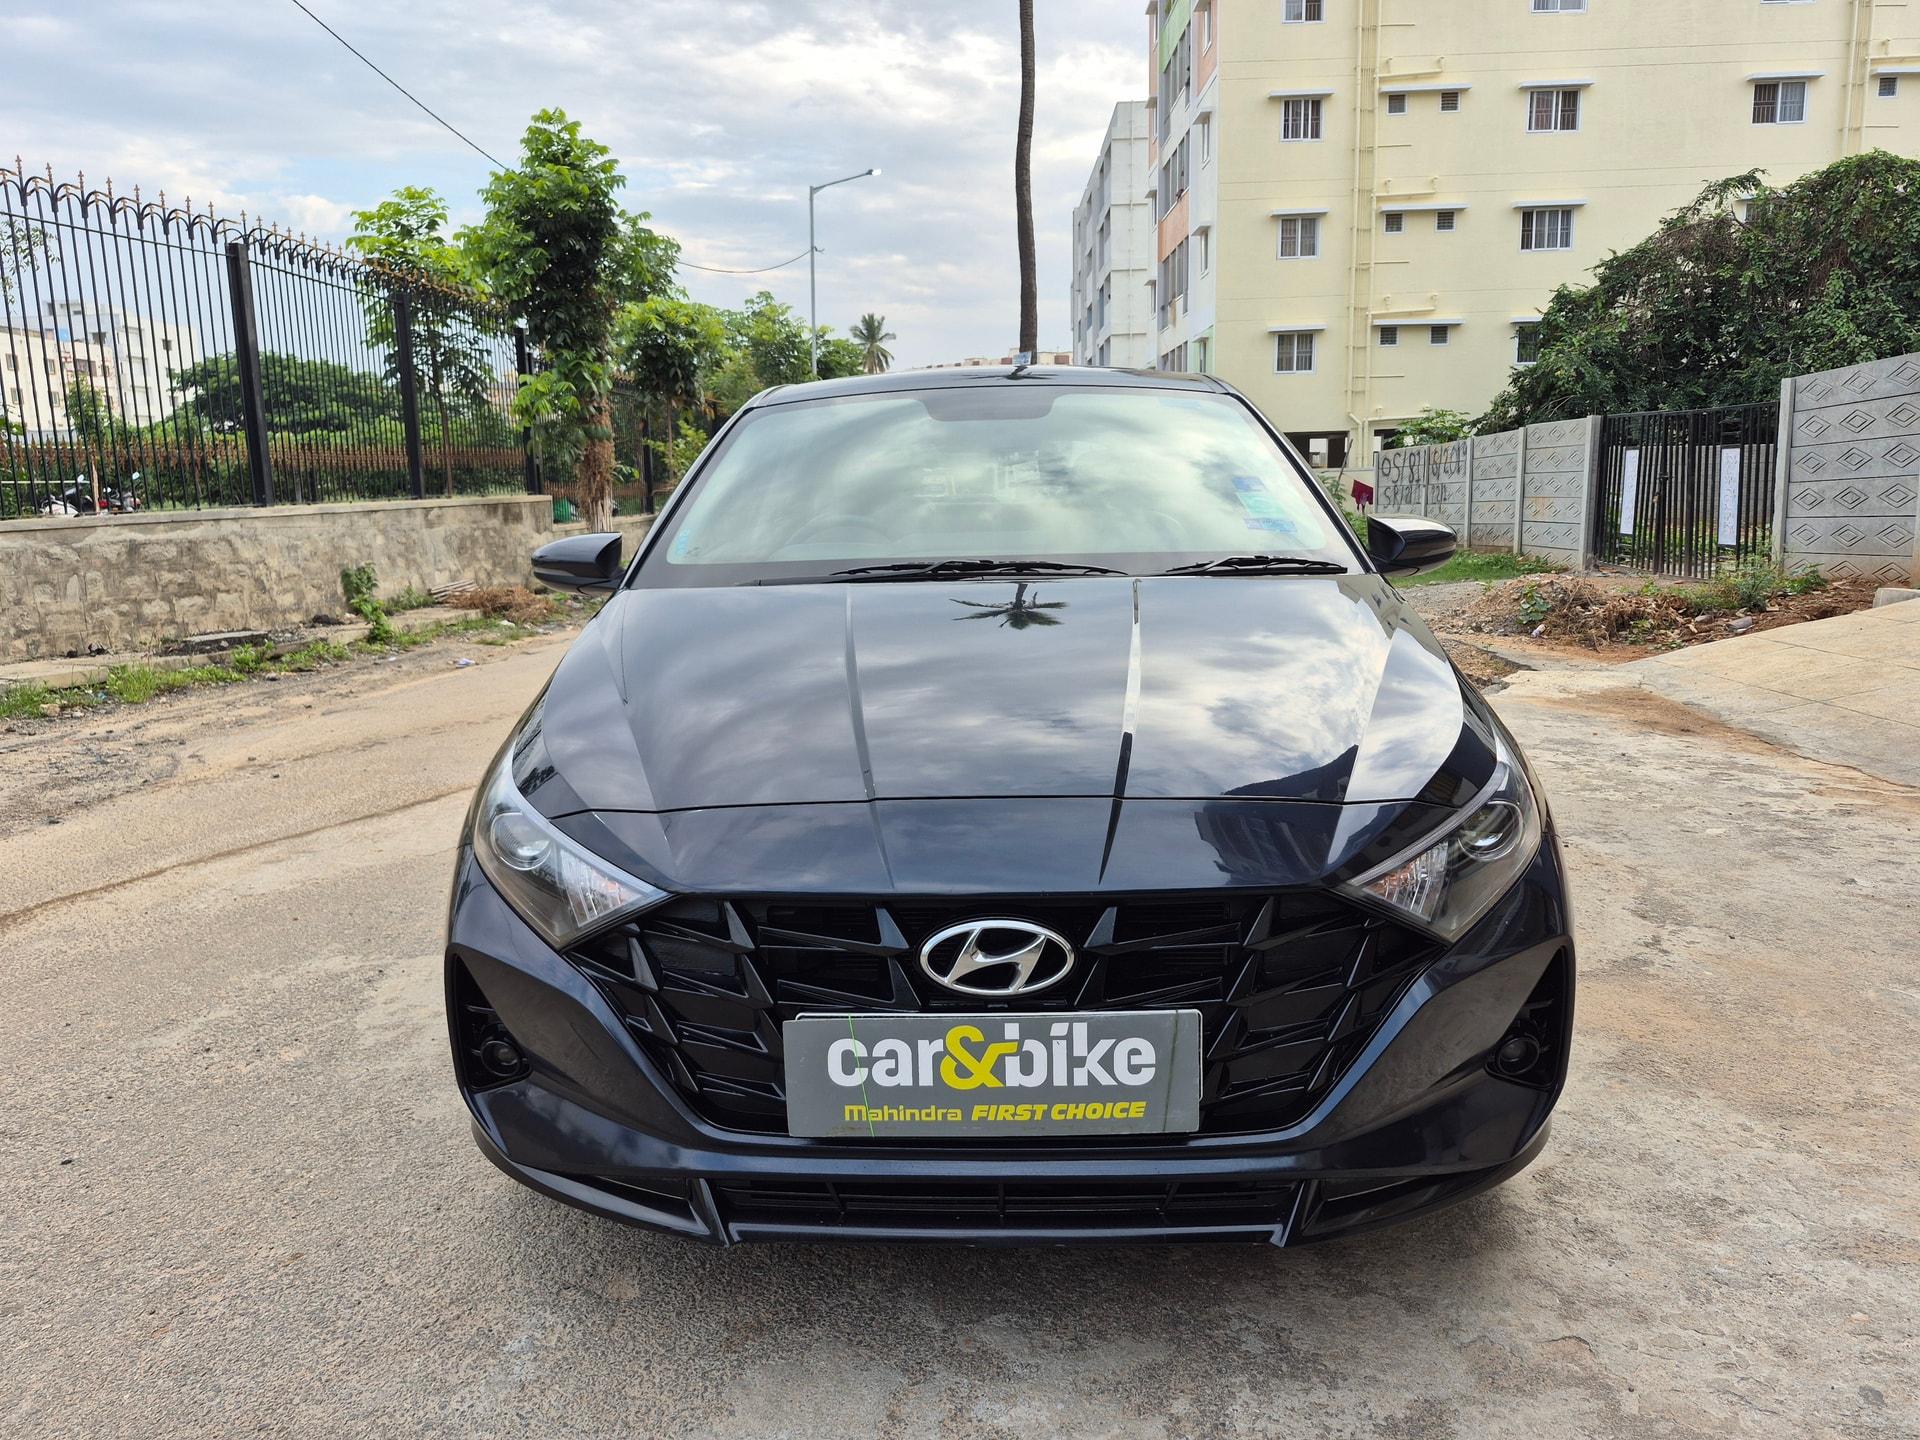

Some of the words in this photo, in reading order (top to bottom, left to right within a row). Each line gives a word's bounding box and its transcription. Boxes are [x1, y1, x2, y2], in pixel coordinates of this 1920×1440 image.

[828, 1022, 1156, 1090] car&bike
[844, 1105, 962, 1121] Mahindra
[971, 1104, 1048, 1121] FIRST
[1051, 1101, 1147, 1120] CHOICE
